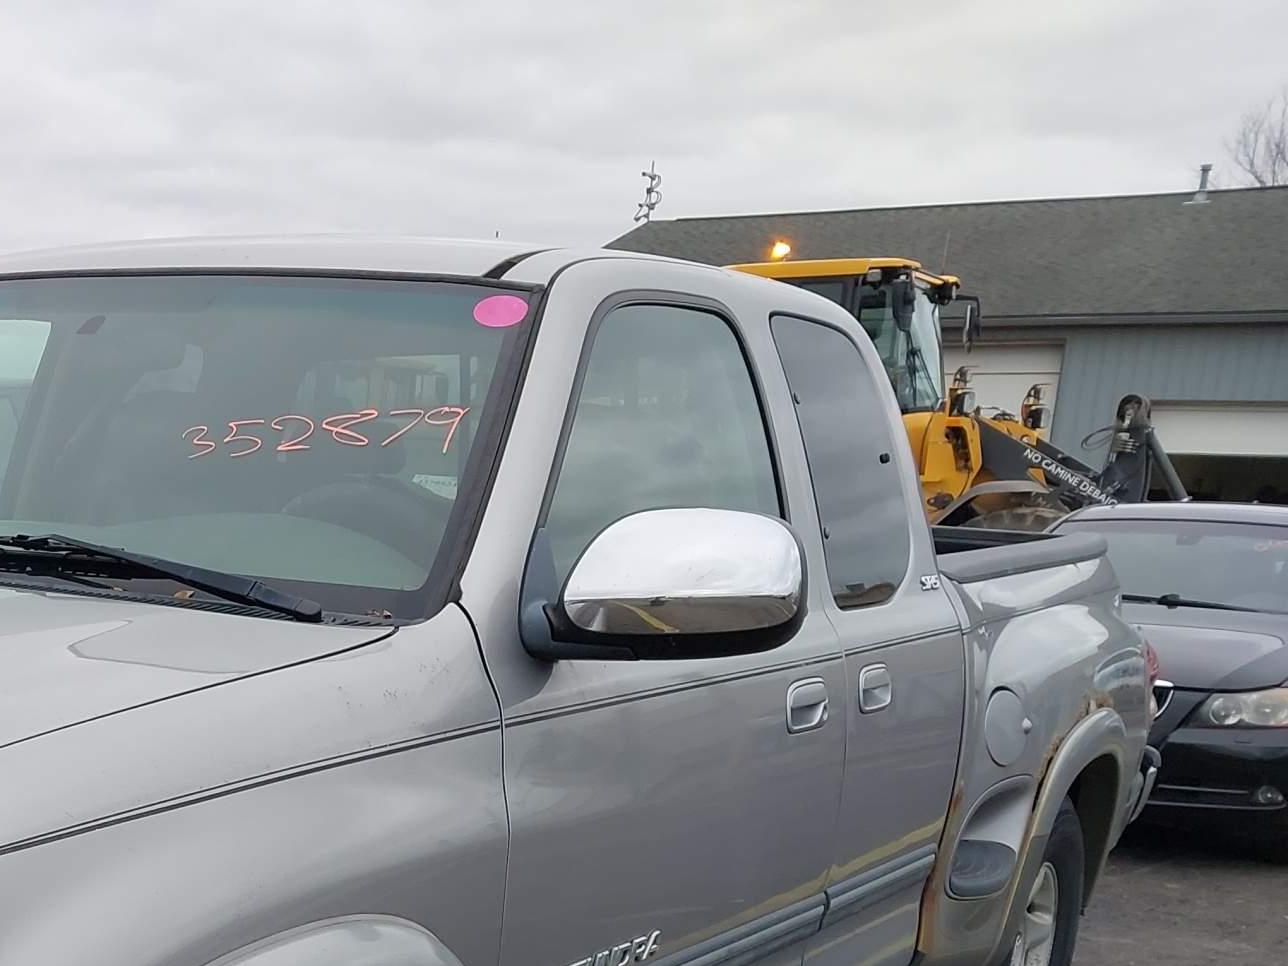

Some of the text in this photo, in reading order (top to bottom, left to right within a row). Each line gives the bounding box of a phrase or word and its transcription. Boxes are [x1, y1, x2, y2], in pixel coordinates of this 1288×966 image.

[182, 406, 470, 459] 352879
[1023, 448, 1042, 463] NO
[1041, 459, 1081, 487] CAMINE
